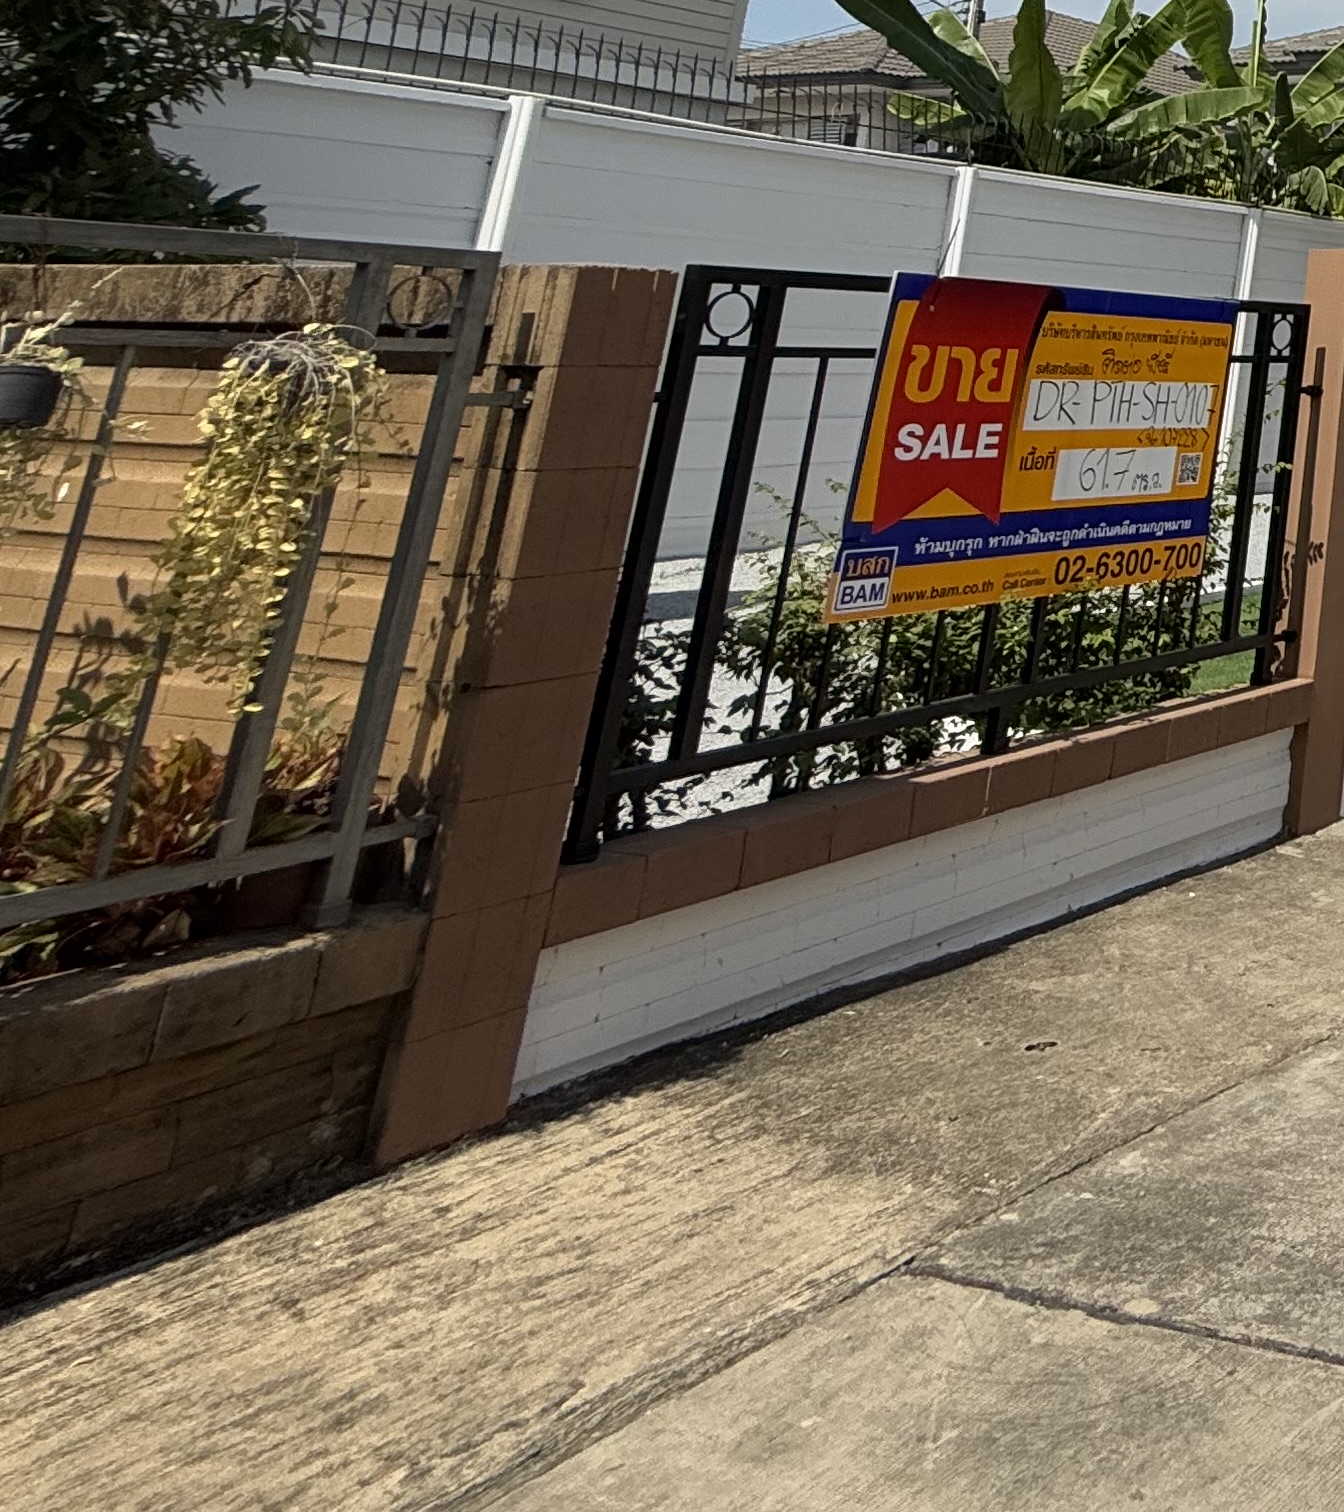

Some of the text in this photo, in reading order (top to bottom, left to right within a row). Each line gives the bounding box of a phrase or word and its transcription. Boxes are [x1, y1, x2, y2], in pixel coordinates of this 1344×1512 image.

[904, 344, 1019, 403] ขาย
[894, 423, 1003, 461] SALE
[1019, 445, 1057, 472] เนื้อที่
[914, 518, 1193, 558] ห้ามบุกรุก หากฝ่าฝืนจะถูกดำเนินคดีตามกฎหมาย
[845, 555, 890, 578] บสก
[1053, 541, 1203, 586] 02-6300-700
[840, 580, 887, 605] BAM
[891, 579, 994, 604] www.bam.co.th
[1002, 579, 1019, 592] Call
